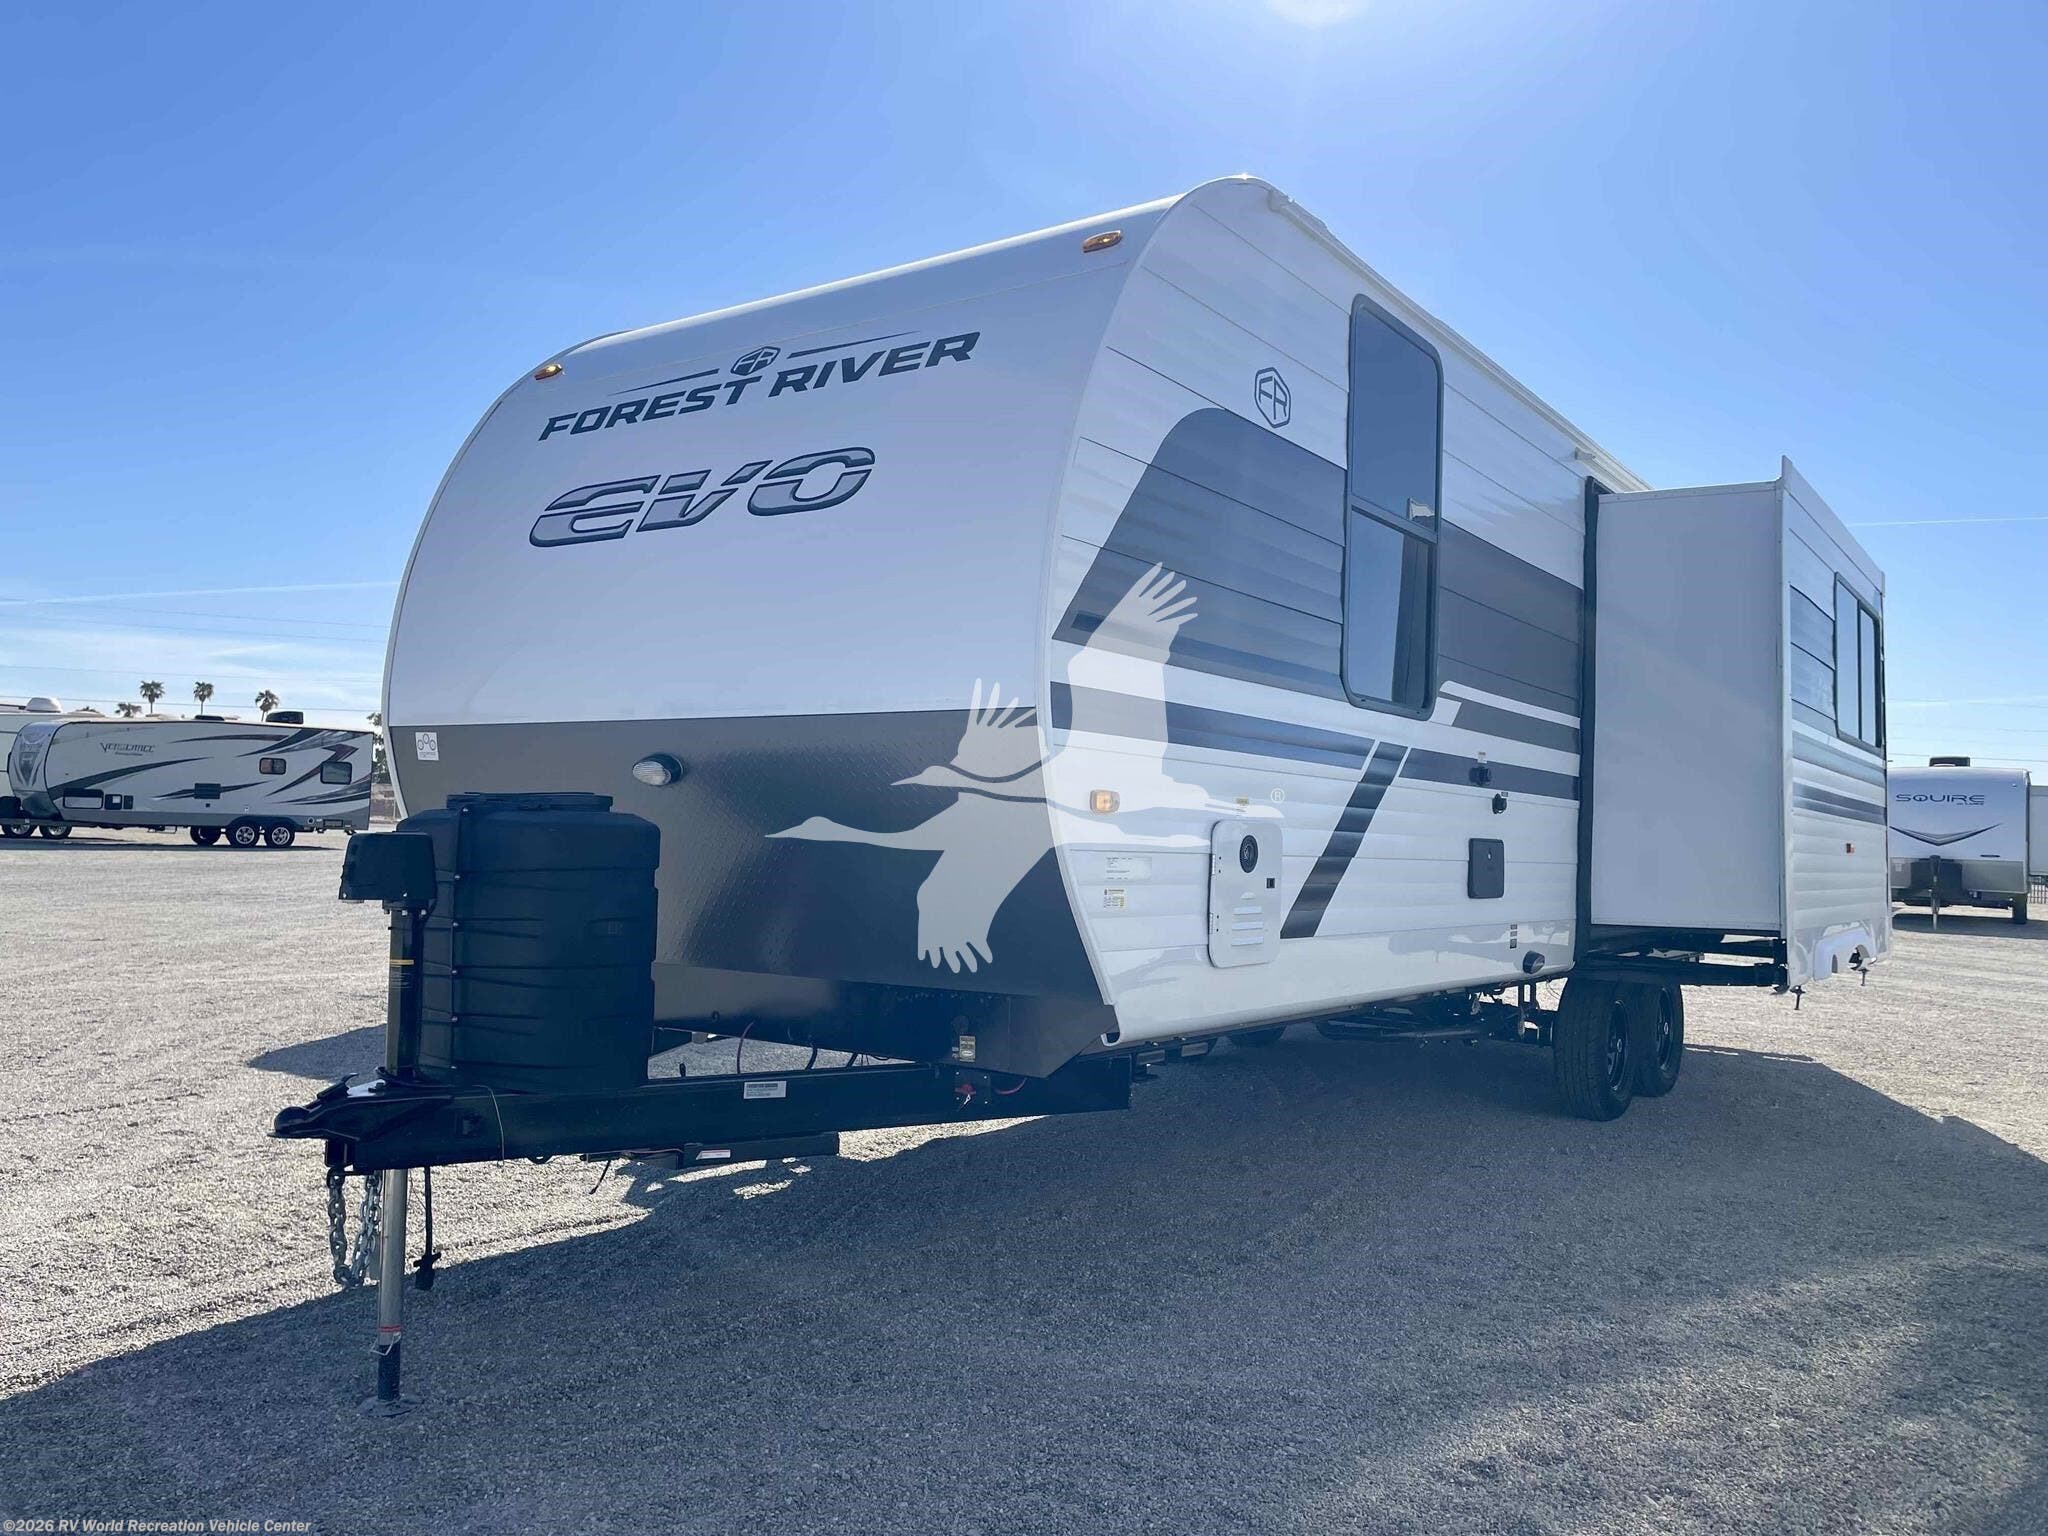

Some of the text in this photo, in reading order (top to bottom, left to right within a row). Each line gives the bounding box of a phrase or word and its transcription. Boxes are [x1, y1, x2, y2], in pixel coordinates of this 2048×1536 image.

[538, 331, 981, 441] FOREST RIVER
[529, 447, 875, 548] EVO
[1896, 794, 1985, 802] SQUIRE
